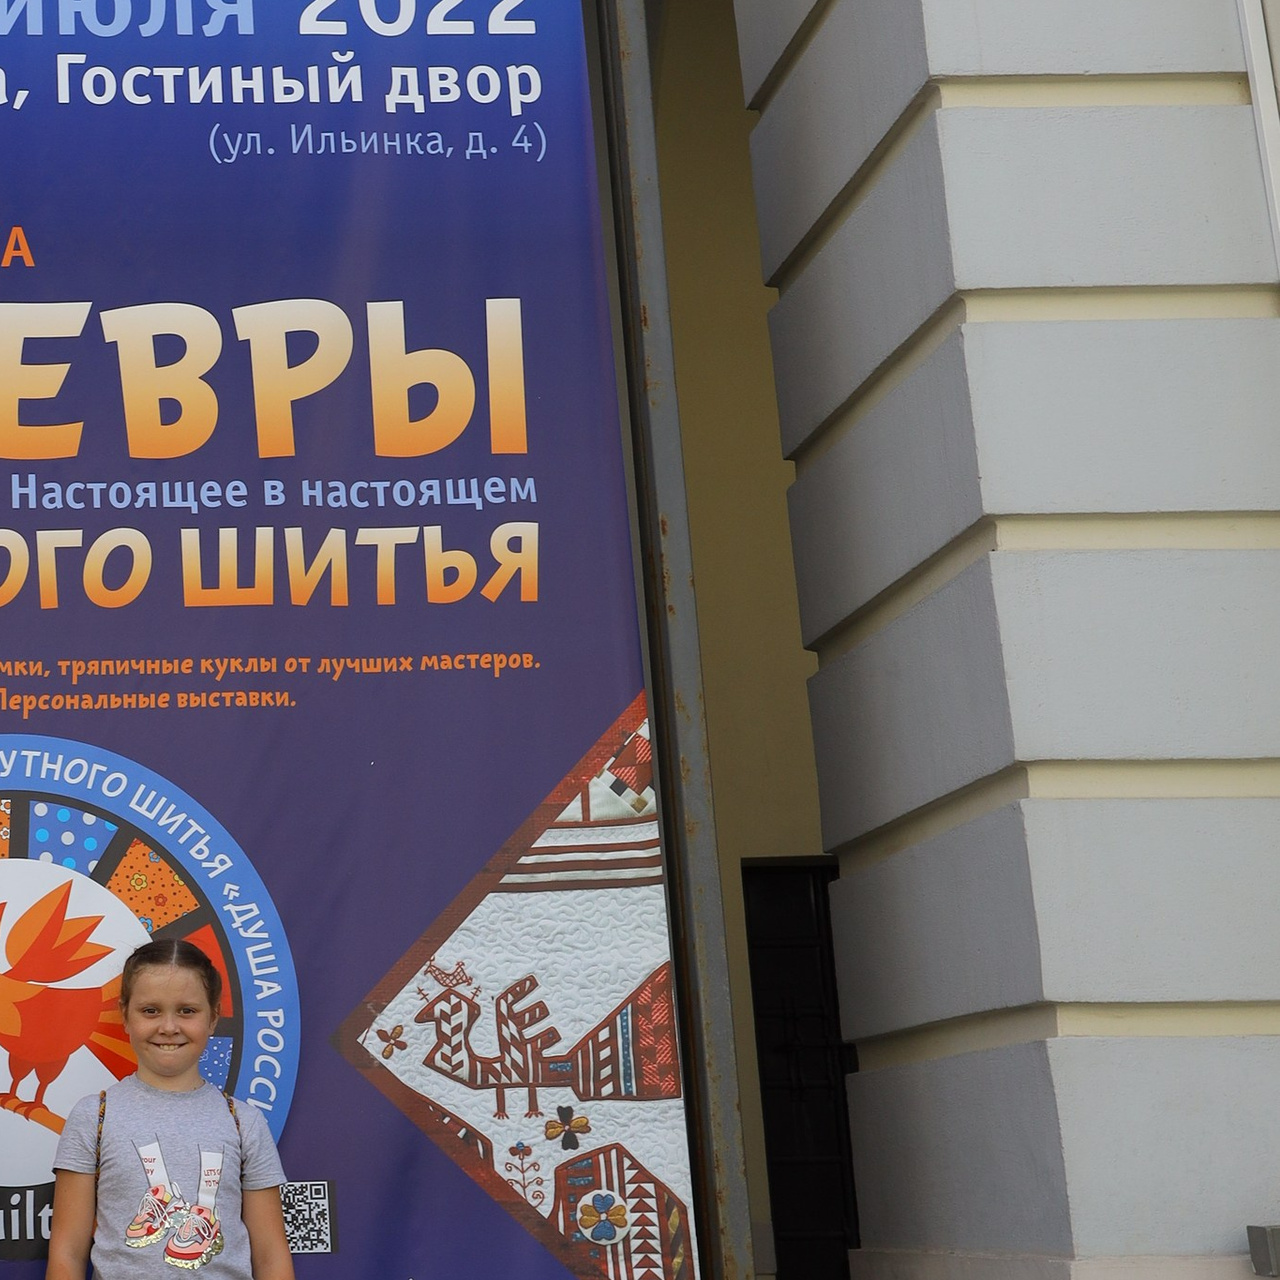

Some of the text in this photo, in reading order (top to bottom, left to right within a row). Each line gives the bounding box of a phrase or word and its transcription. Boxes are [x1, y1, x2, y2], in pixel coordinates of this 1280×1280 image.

[56, 51, 363, 105] Гостиный
[385, 62, 543, 116] двор
[208, 121, 547, 163] (ул. Ильинка, д. 4)
[10, 474, 538, 514] Настоящее в настоящем
[179, 521, 540, 608] ШИТЬЯ
[57, 658, 193, 685] тряпичные
[200, 656, 277, 682] куклы
[285, 657, 311, 674] от
[317, 655, 413, 681] лучших
[420, 651, 541, 677] мастеров.
[177, 688, 297, 709] выставки.
[128, 783, 234, 879] ШИТЬЯ
